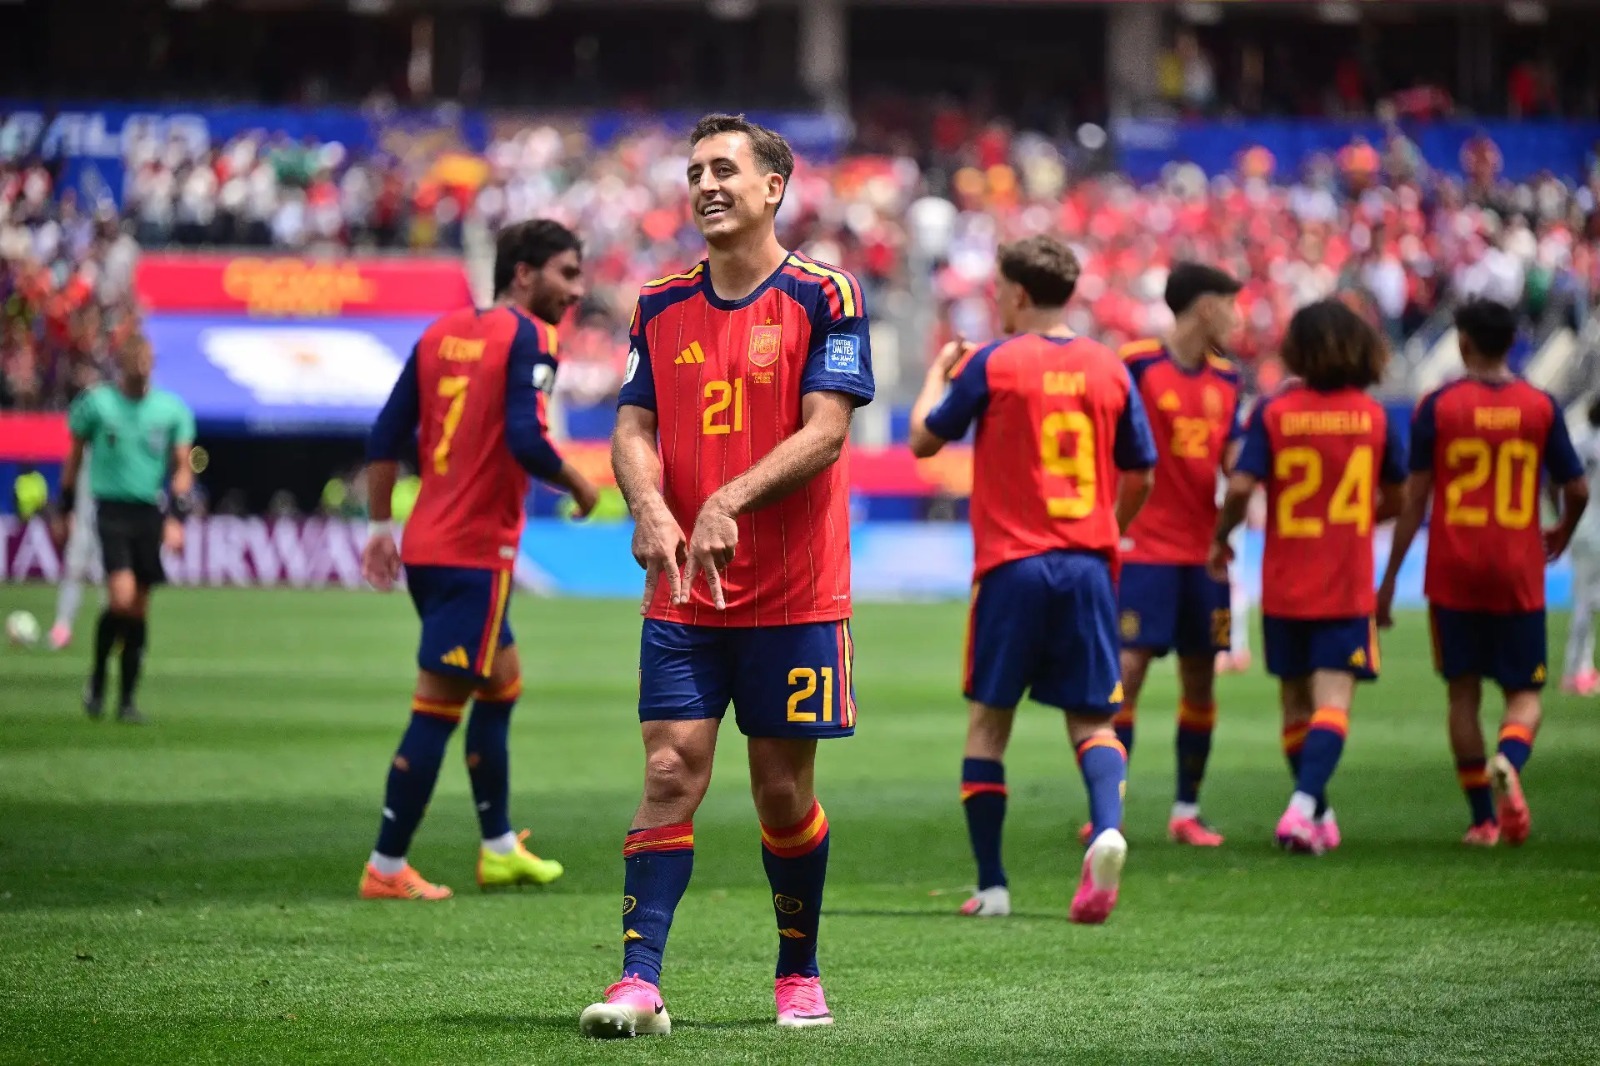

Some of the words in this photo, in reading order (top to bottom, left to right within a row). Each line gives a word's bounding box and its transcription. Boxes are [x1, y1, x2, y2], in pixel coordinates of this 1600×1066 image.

[832, 345, 854, 355] UNITES
[434, 376, 469, 475] 7
[703, 377, 743, 434] 21
[1041, 411, 1096, 518] 9
[1275, 446, 1374, 538] 24
[1446, 438, 1538, 529] 20
[787, 667, 833, 722] 21
